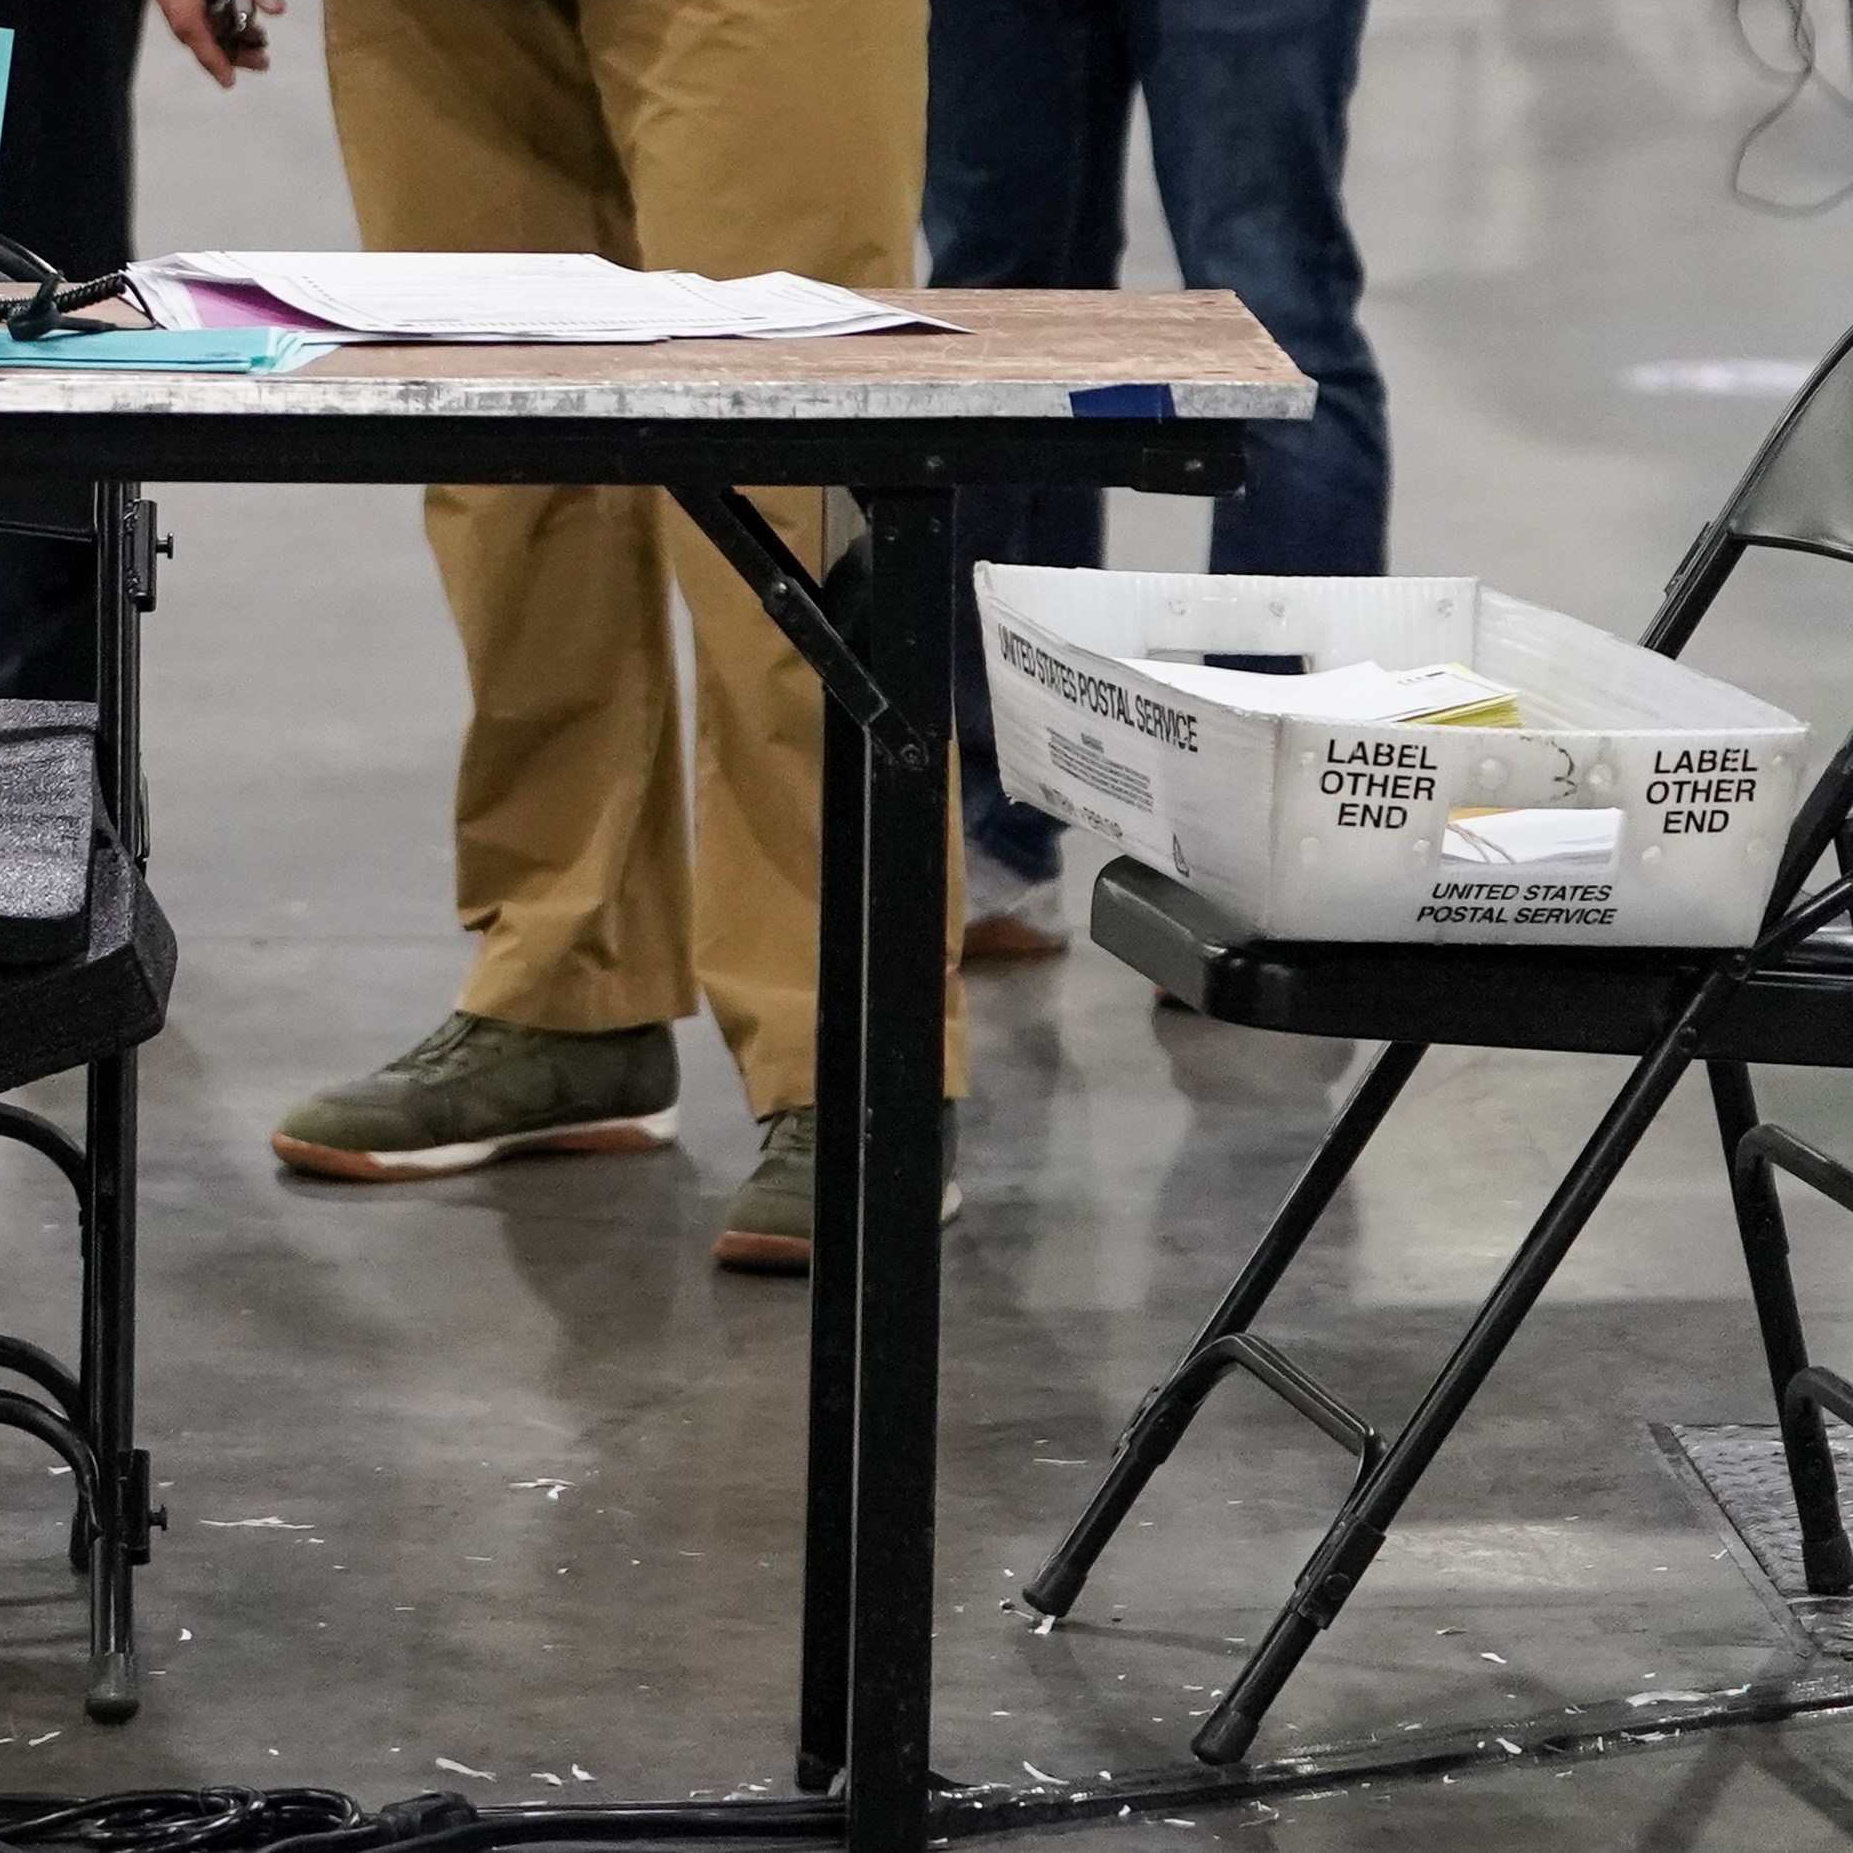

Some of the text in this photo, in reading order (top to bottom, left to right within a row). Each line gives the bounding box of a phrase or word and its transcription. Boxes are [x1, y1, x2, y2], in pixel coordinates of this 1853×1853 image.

[998, 623, 1198, 753] UNITED STATES POSTAL SERVICE
[1327, 739, 1437, 770] LABEL
[1654, 748, 1758, 774] LABEL
[1320, 770, 1436, 801] OTHER
[1646, 779, 1757, 804] OTHER
[1338, 803, 1408, 829] END
[1663, 810, 1730, 834] END
[1432, 883, 1613, 901] UNITED STATES
[1417, 906, 1618, 925] POSTAL SERVICE
